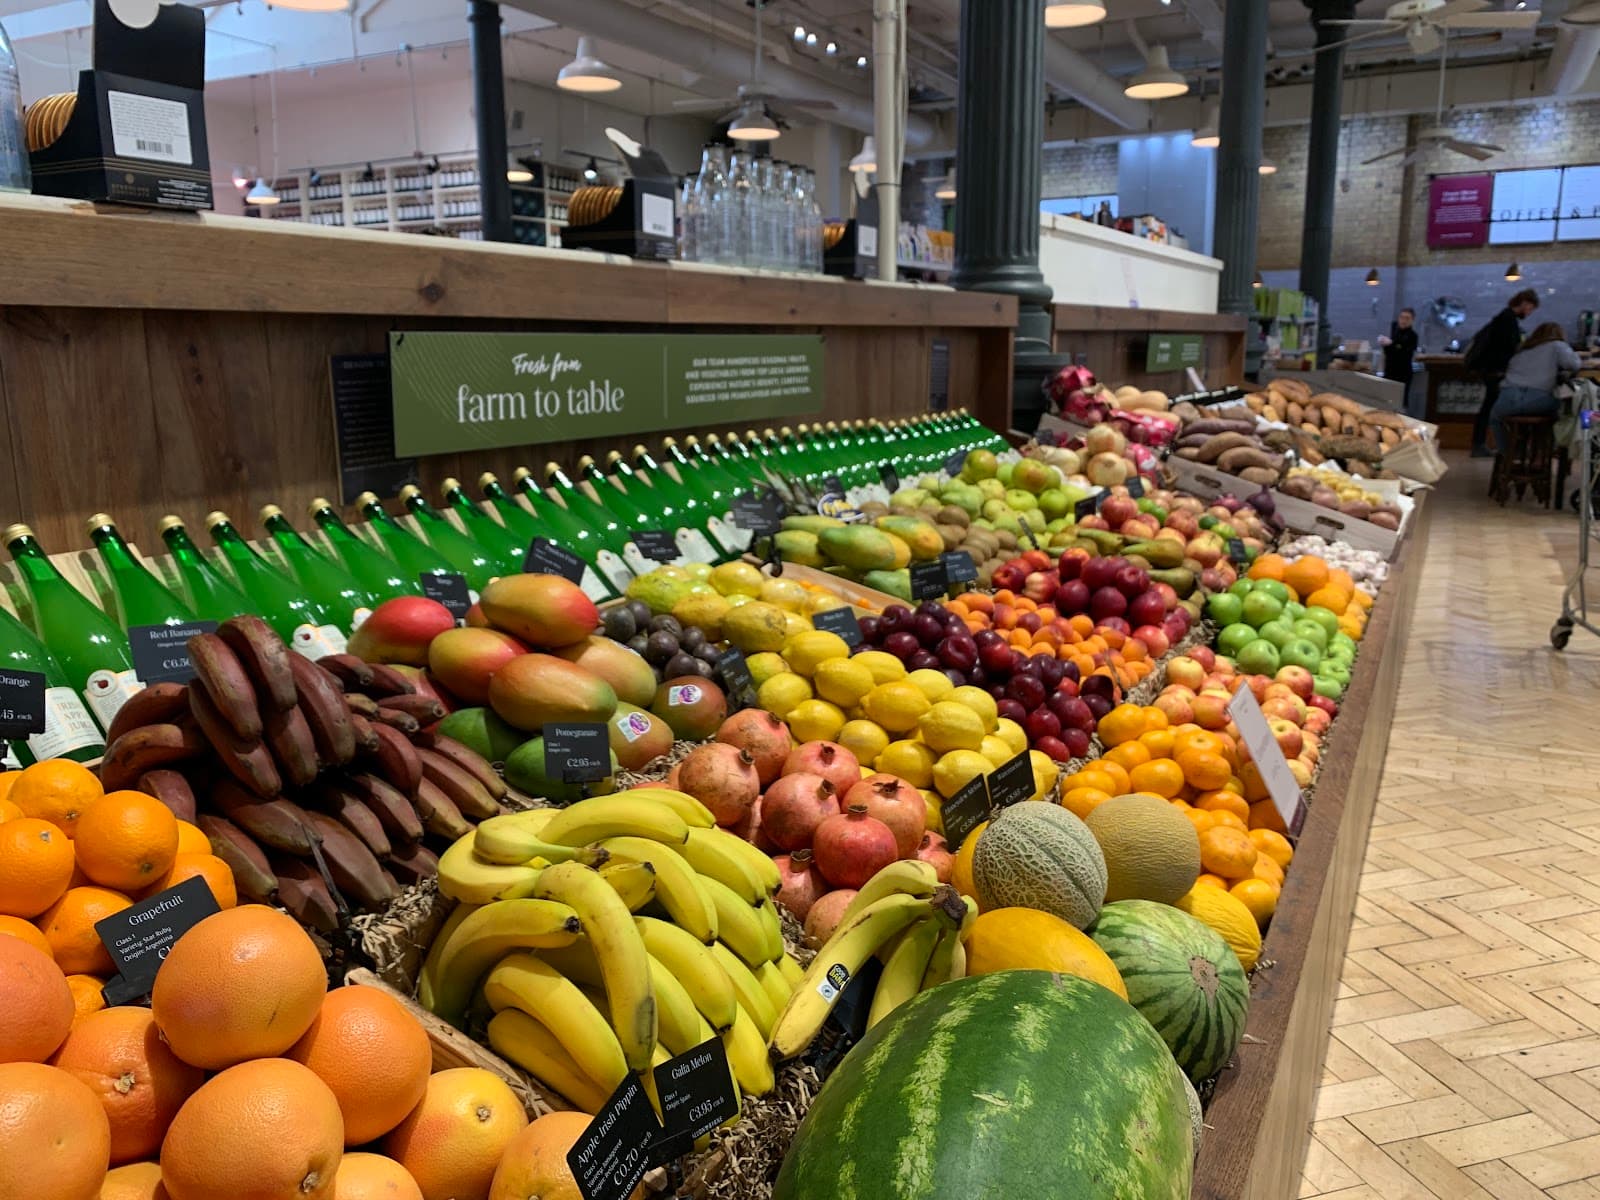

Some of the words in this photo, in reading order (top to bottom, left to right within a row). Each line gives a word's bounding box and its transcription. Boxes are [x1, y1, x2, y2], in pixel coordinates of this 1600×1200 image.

[511, 352, 549, 376] Fresh
[549, 352, 583, 382] from
[458, 383, 527, 423] farm
[534, 386, 561, 418] to
[567, 379, 625, 415] table
[150, 630, 168, 639] Red
[169, 629, 203, 638] Banana
[555, 728, 599, 738] Pomegranate
[128, 895, 184, 926] Grapefruit
[115, 936, 132, 947] Class
[142, 933, 156, 943] Star
[155, 926, 172, 937] Ruby
[145, 934, 174, 951] Argentina
[671, 1063, 691, 1080] Galia
[691, 1052, 712, 1070] Melon
[664, 1091, 675, 1102] Class
[688, 1099, 713, 1122] €3.95
[713, 1096, 725, 1109] each
[577, 1134, 601, 1168] Apple
[599, 1113, 617, 1139] Irish
[614, 1083, 638, 1117] Pippin
[584, 1163, 595, 1180] Class
[613, 1147, 639, 1186] €0.70
